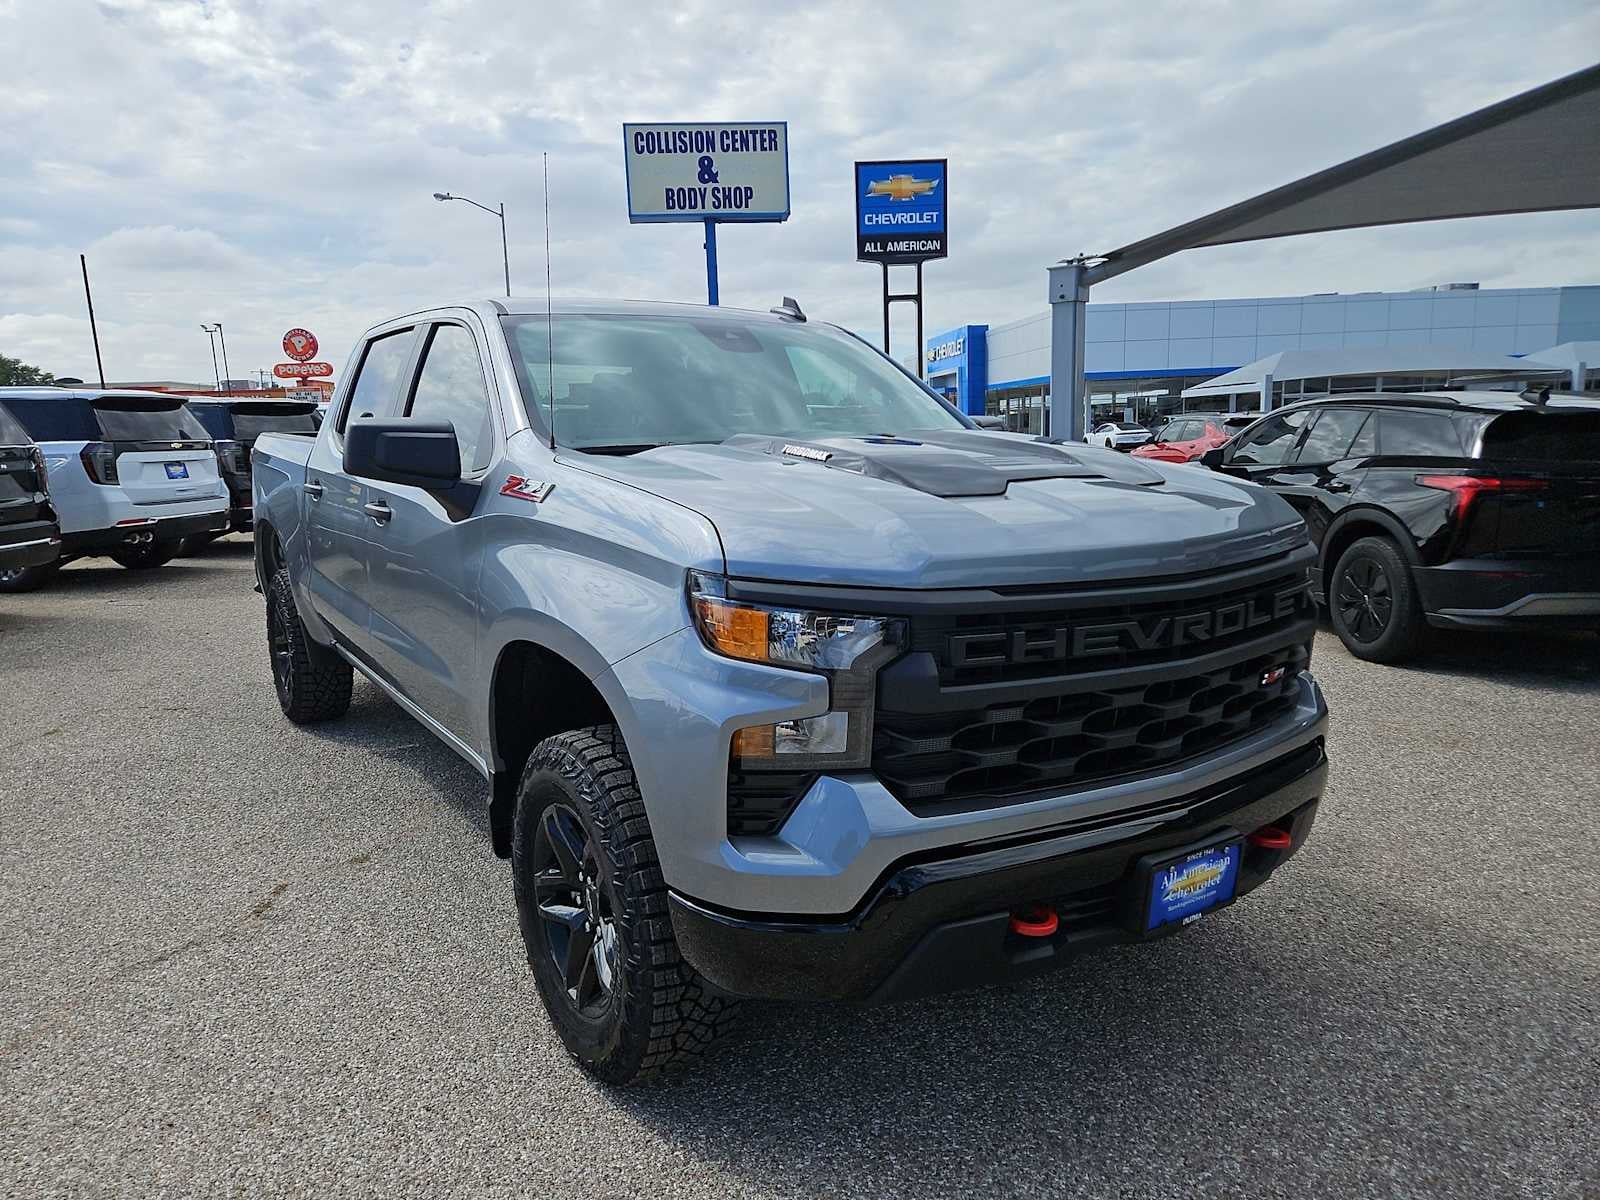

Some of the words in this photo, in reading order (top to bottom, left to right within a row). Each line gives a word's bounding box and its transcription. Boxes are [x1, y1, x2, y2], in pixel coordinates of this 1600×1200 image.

[633, 130, 716, 155] COLLISION
[719, 129, 778, 153] CENTER
[697, 155, 719, 184] &
[665, 187, 707, 210] BODY
[711, 186, 754, 209] SHOP
[864, 211, 939, 225] CHEVROLET
[864, 241, 884, 253] ALL
[886, 240, 941, 252] AMERICAN
[781, 444, 832, 461] TURBOMAX
[499, 473, 556, 503] Z71
[1160, 872, 1178, 890] All
[1182, 856, 1231, 880] American
[1168, 876, 1221, 901] Chevrolet
